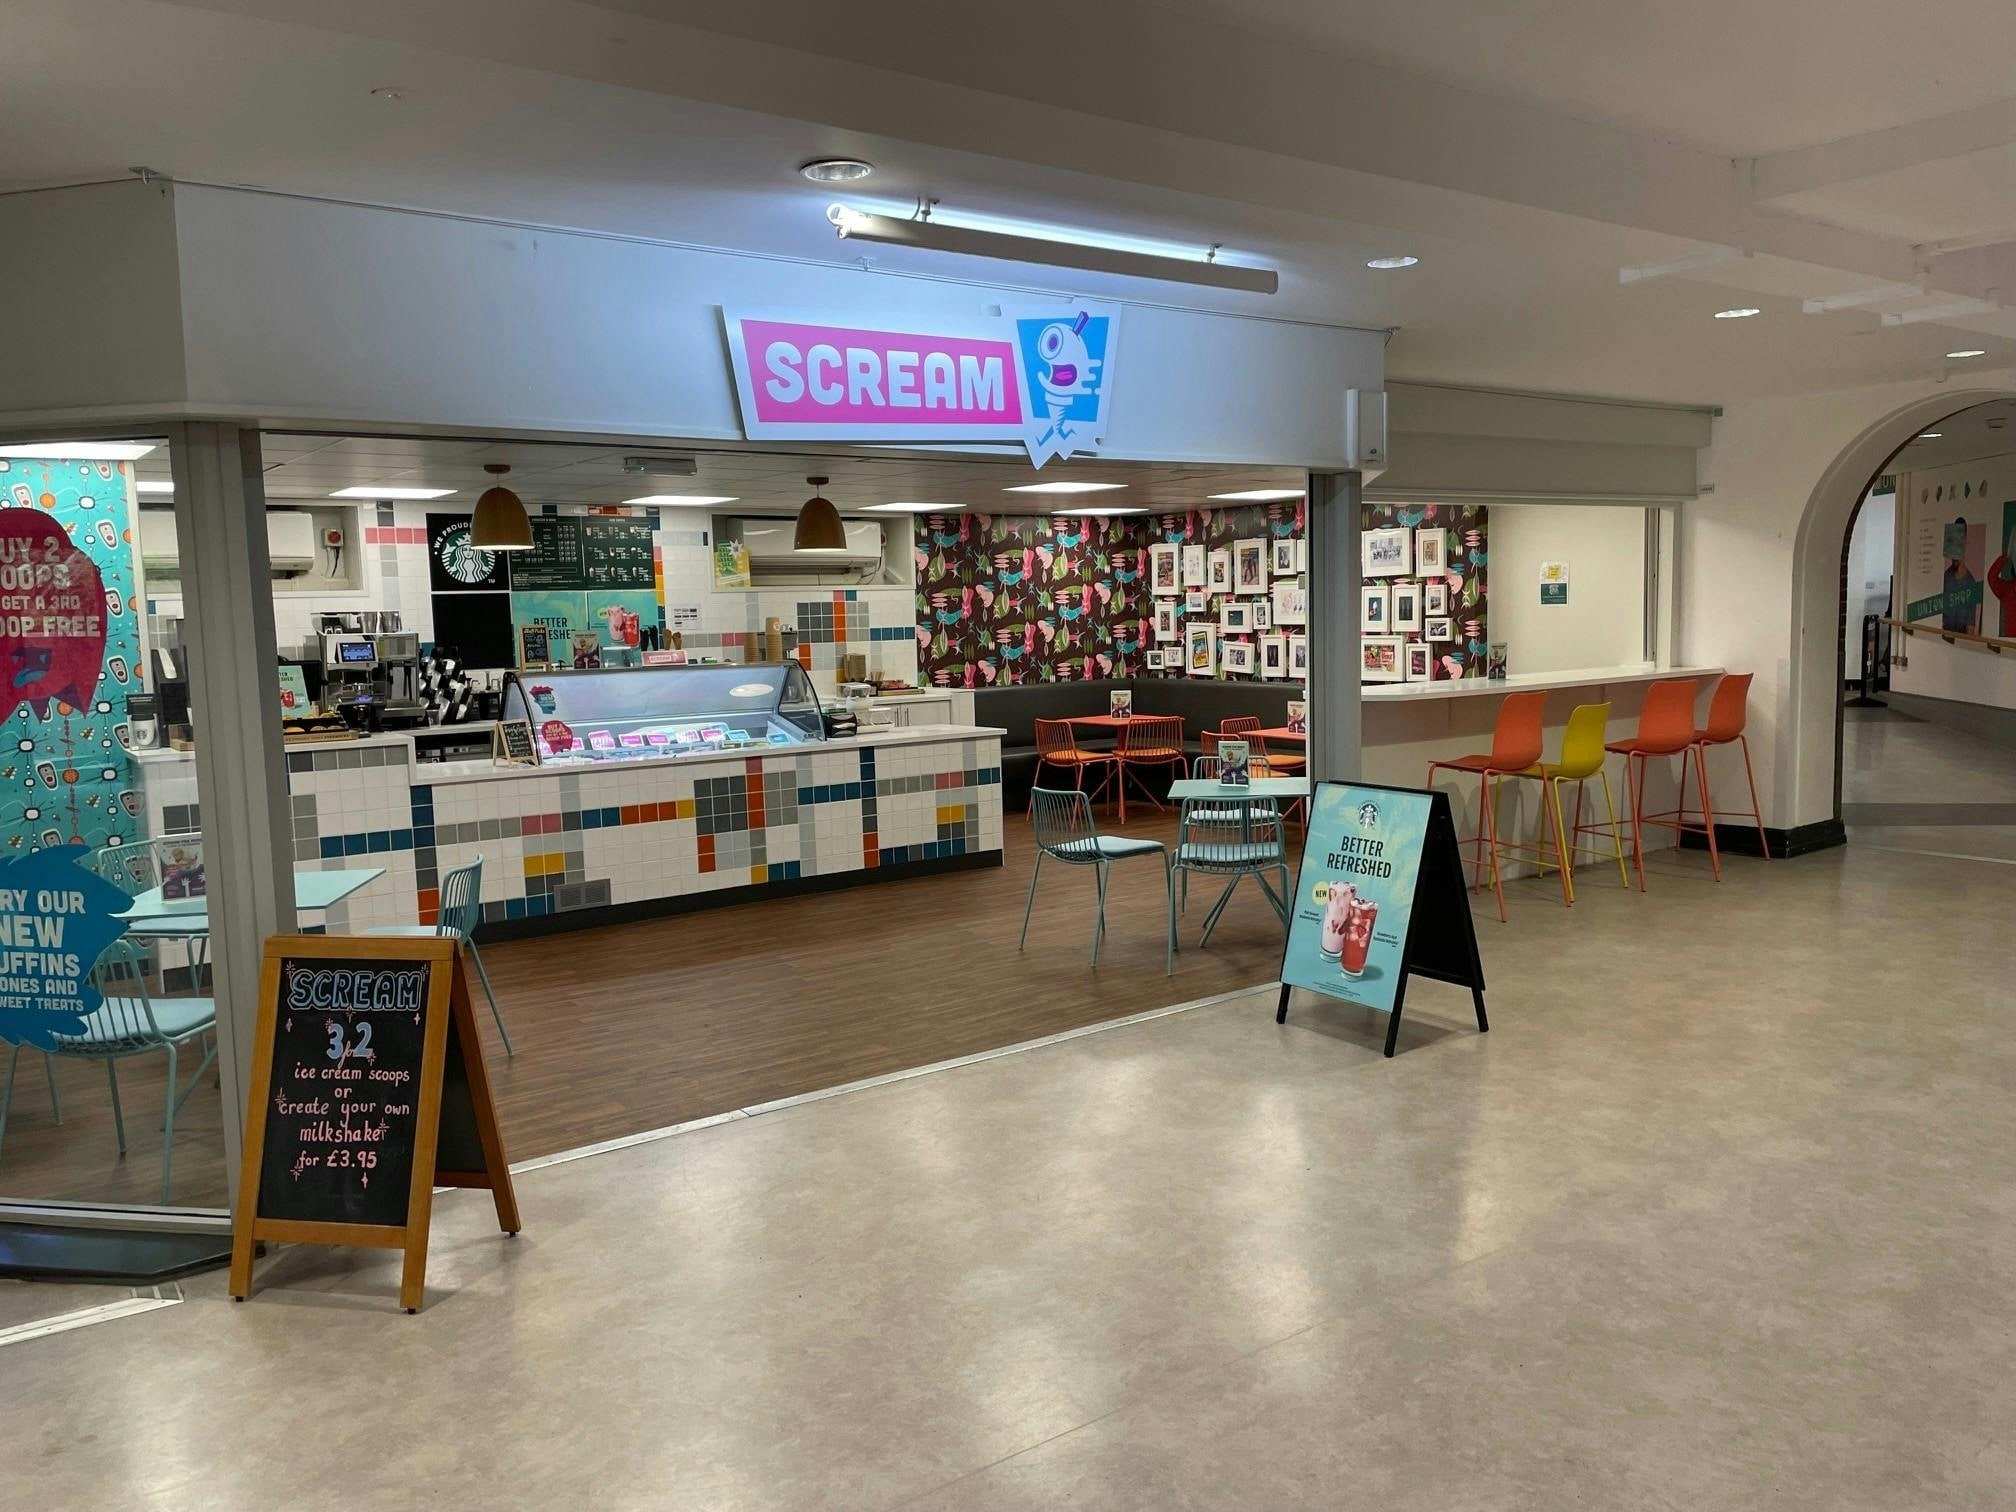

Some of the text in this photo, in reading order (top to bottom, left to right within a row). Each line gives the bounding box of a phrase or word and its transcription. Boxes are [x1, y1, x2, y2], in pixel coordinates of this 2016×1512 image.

[765, 341, 1005, 412] SCREAM
[442, 522, 472, 537] PROUD
[44, 536, 60, 562] 2
[0, 564, 70, 590] OOPS
[1, 595, 81, 610] GET A 3RD
[1918, 589, 1972, 616] UNION SHOP
[43, 616, 100, 637] FREE
[534, 617, 567, 627] BETTER
[549, 629, 576, 640] ESHE
[1341, 836, 1384, 858] BETTER
[1327, 853, 1392, 879] REFRESHED
[0, 889, 86, 914] RY OUR
[1315, 888, 1327, 898] NEW
[0, 915, 64, 948] NEW
[0, 977, 77, 995] ONES AND
[288, 969, 422, 1011] SCREAM
[35, 998, 84, 1011] TREATS
[326, 1022, 344, 1060] 3
[353, 1021, 373, 1058] 2
[294, 1061, 410, 1087] ice cream scoops
[334, 1087, 352, 1099] or
[279, 1097, 410, 1128] create your own
[300, 1120, 381, 1143] milkshake
[299, 1150, 377, 1169] for £3.95
